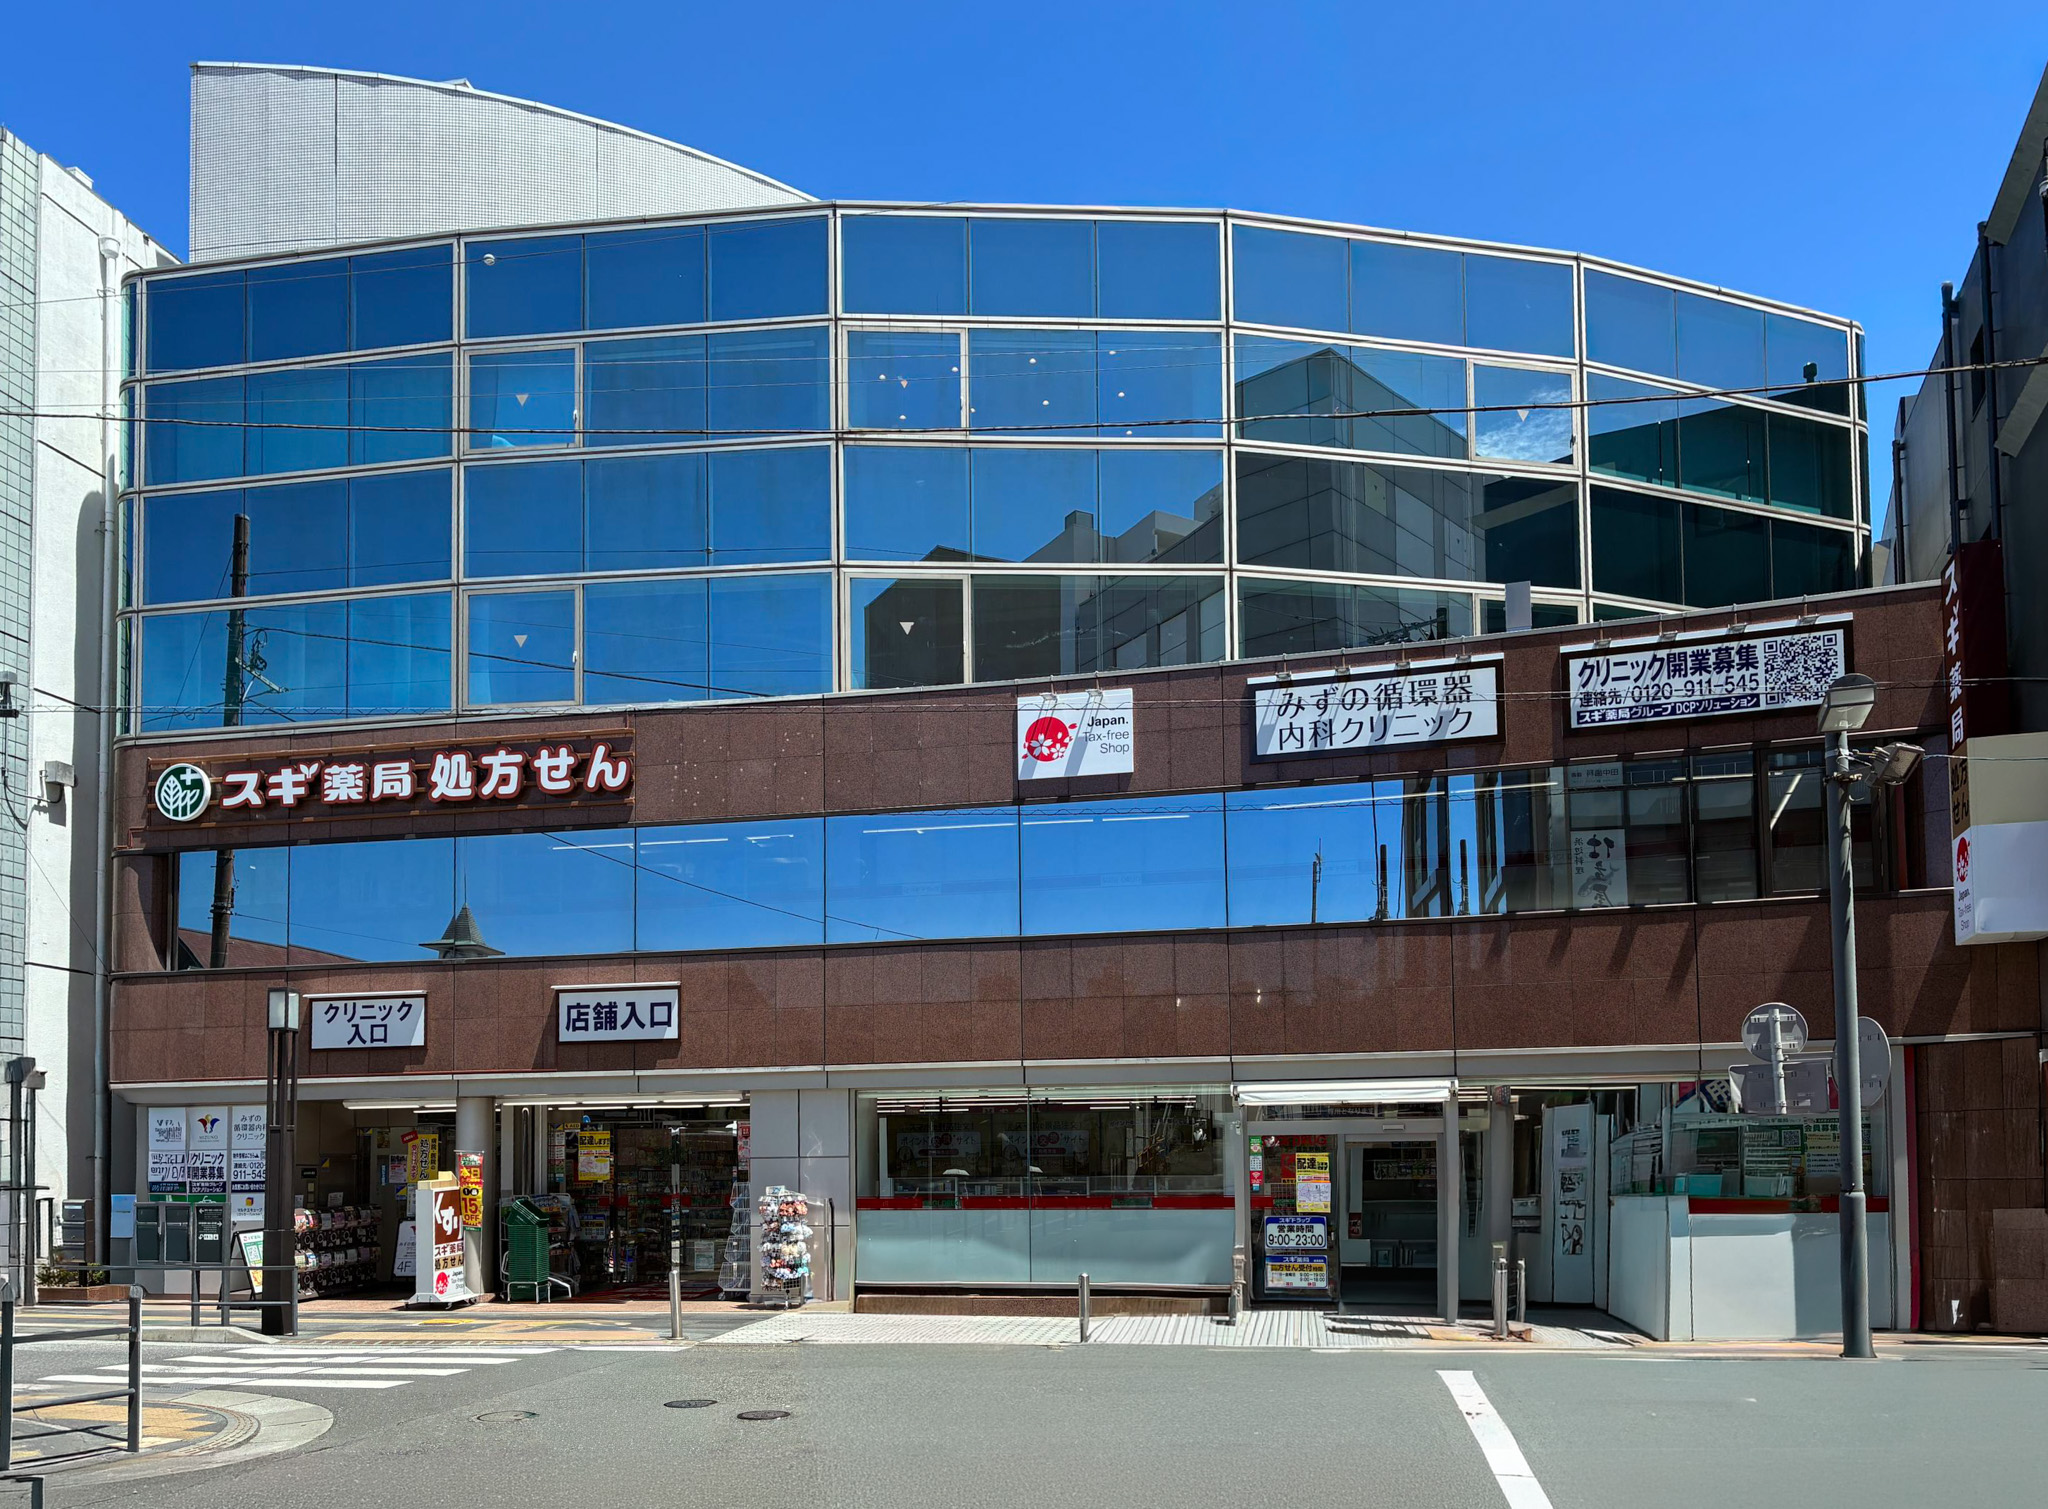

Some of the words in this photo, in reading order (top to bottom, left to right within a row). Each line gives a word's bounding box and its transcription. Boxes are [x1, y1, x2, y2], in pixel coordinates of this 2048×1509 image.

[1944, 559, 1965, 751] スギ薬局
[1578, 644, 1760, 689] クリニック開業募集
[1277, 675, 1473, 719] みずの循環器
[1087, 716, 1129, 729] Japan.
[1279, 707, 1472, 751] 内科クリニック
[1083, 730, 1130, 742] Tax-free
[1100, 743, 1130, 755] Shop
[220, 762, 413, 809] スギ薬局
[429, 742, 632, 802] 処方せん
[323, 1000, 413, 1024] クリニック
[565, 1001, 673, 1033] 店舗入口
[347, 1024, 388, 1045] 入口
[240, 1115, 262, 1123] みずの
[1804, 1124, 1840, 1132] 会員募集
[236, 1133, 266, 1141] クリニック
[190, 1152, 225, 1165] クリニック
[419, 1139, 430, 1180] 処方せん
[191, 1166, 225, 1180] 開業募集
[435, 1193, 463, 1240] くすり
[1277, 1225, 1314, 1234] 営業時間
[434, 1242, 464, 1257] スギ薬局
[396, 1261, 412, 1272] 4F
[434, 1255, 464, 1270] 処方せん
